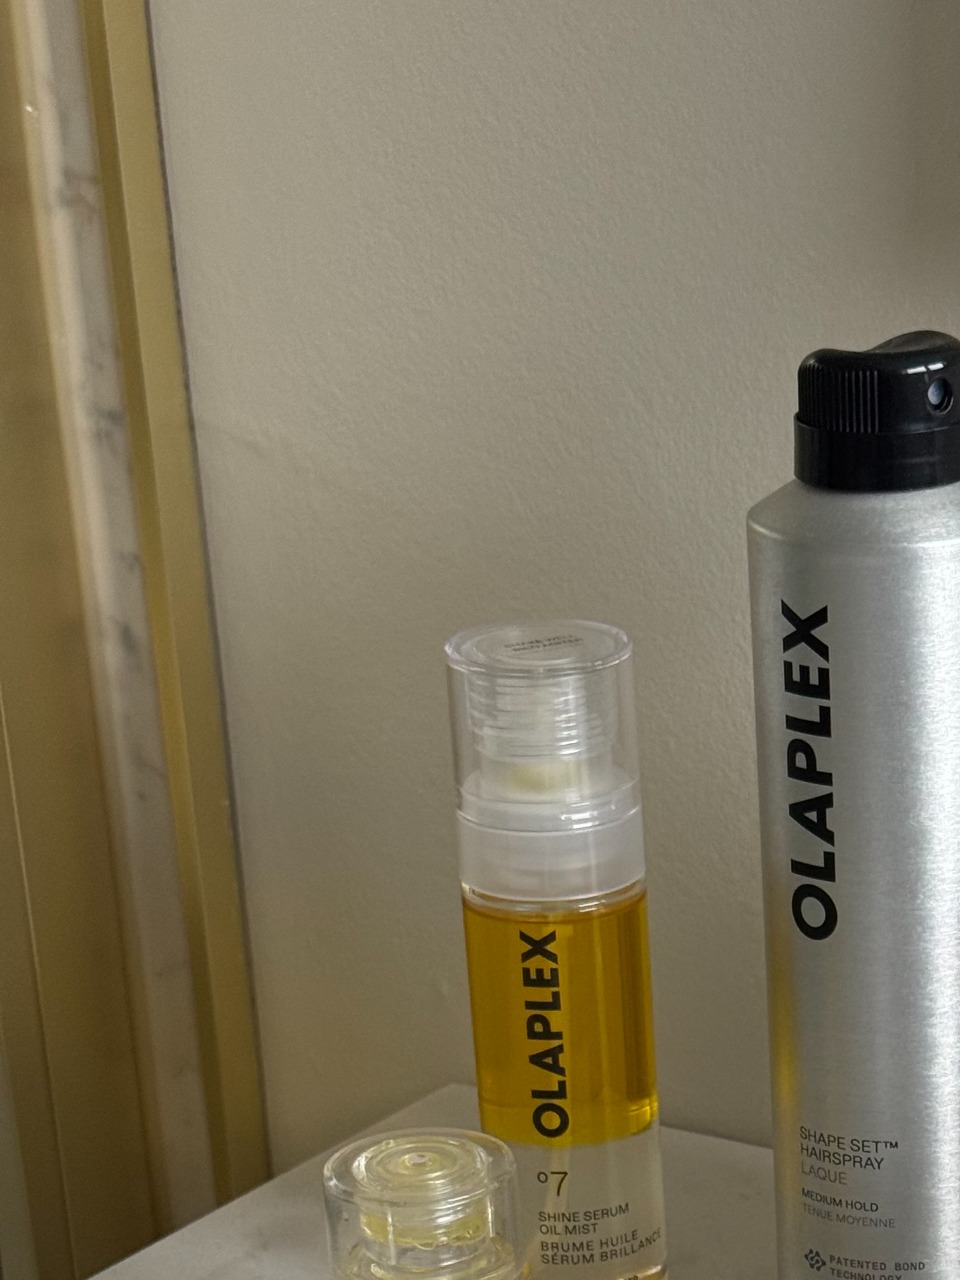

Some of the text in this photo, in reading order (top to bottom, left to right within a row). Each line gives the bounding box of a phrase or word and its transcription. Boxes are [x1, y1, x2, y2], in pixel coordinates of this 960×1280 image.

[781, 599, 838, 941] OLAPLEX
[519, 929, 570, 1138] OLAPLEX
[800, 1126, 846, 1150] SHAPE
[800, 1143, 884, 1170] HAIRSPRAY
[801, 1161, 848, 1185] LAQUE
[538, 1202, 630, 1222] SHINE SERUM
[802, 1188, 878, 1213] MEDIUM HOLD
[802, 1203, 896, 1228] TENUE MOYENNE
[540, 1223, 598, 1235] OIL MIST
[541, 1229, 639, 1253] BRUME HUILE
[541, 1227, 661, 1265] SÉRUM BRILLANCE
[828, 1254, 926, 1271] PATENTED BOND
